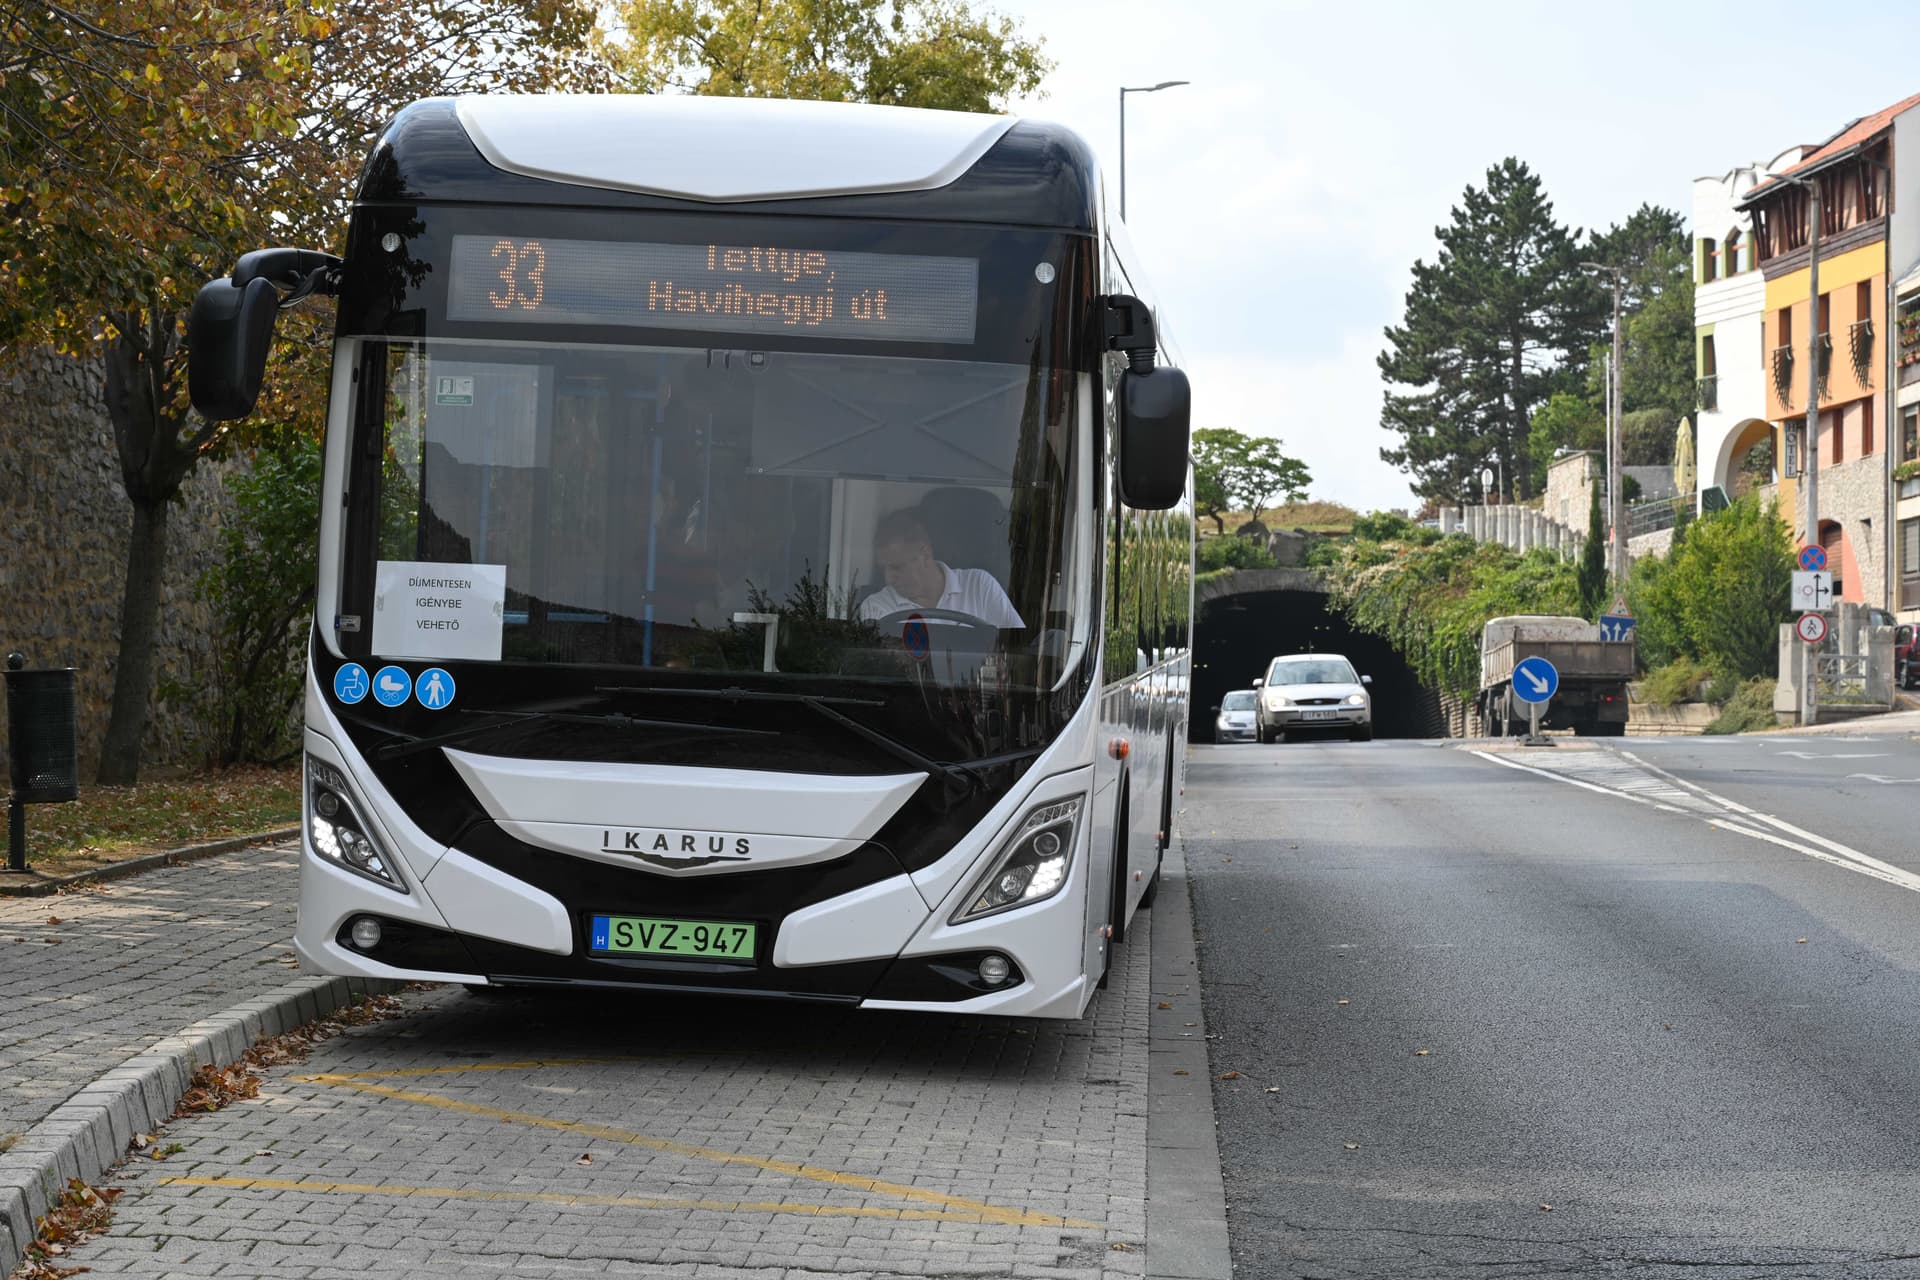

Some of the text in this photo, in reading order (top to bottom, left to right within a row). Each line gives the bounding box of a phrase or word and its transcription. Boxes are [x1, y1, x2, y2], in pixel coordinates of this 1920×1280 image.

[488, 240, 545, 310] 33
[648, 280, 888, 326] Havihegyi út
[1786, 423, 1796, 476] HOTEL
[408, 576, 472, 589] DÍJMENTESEN
[415, 596, 462, 609] IGÉNYBE
[416, 619, 460, 631] VEHETŐ
[603, 830, 750, 855] IKARUS
[596, 921, 748, 954] H SVZ-947
